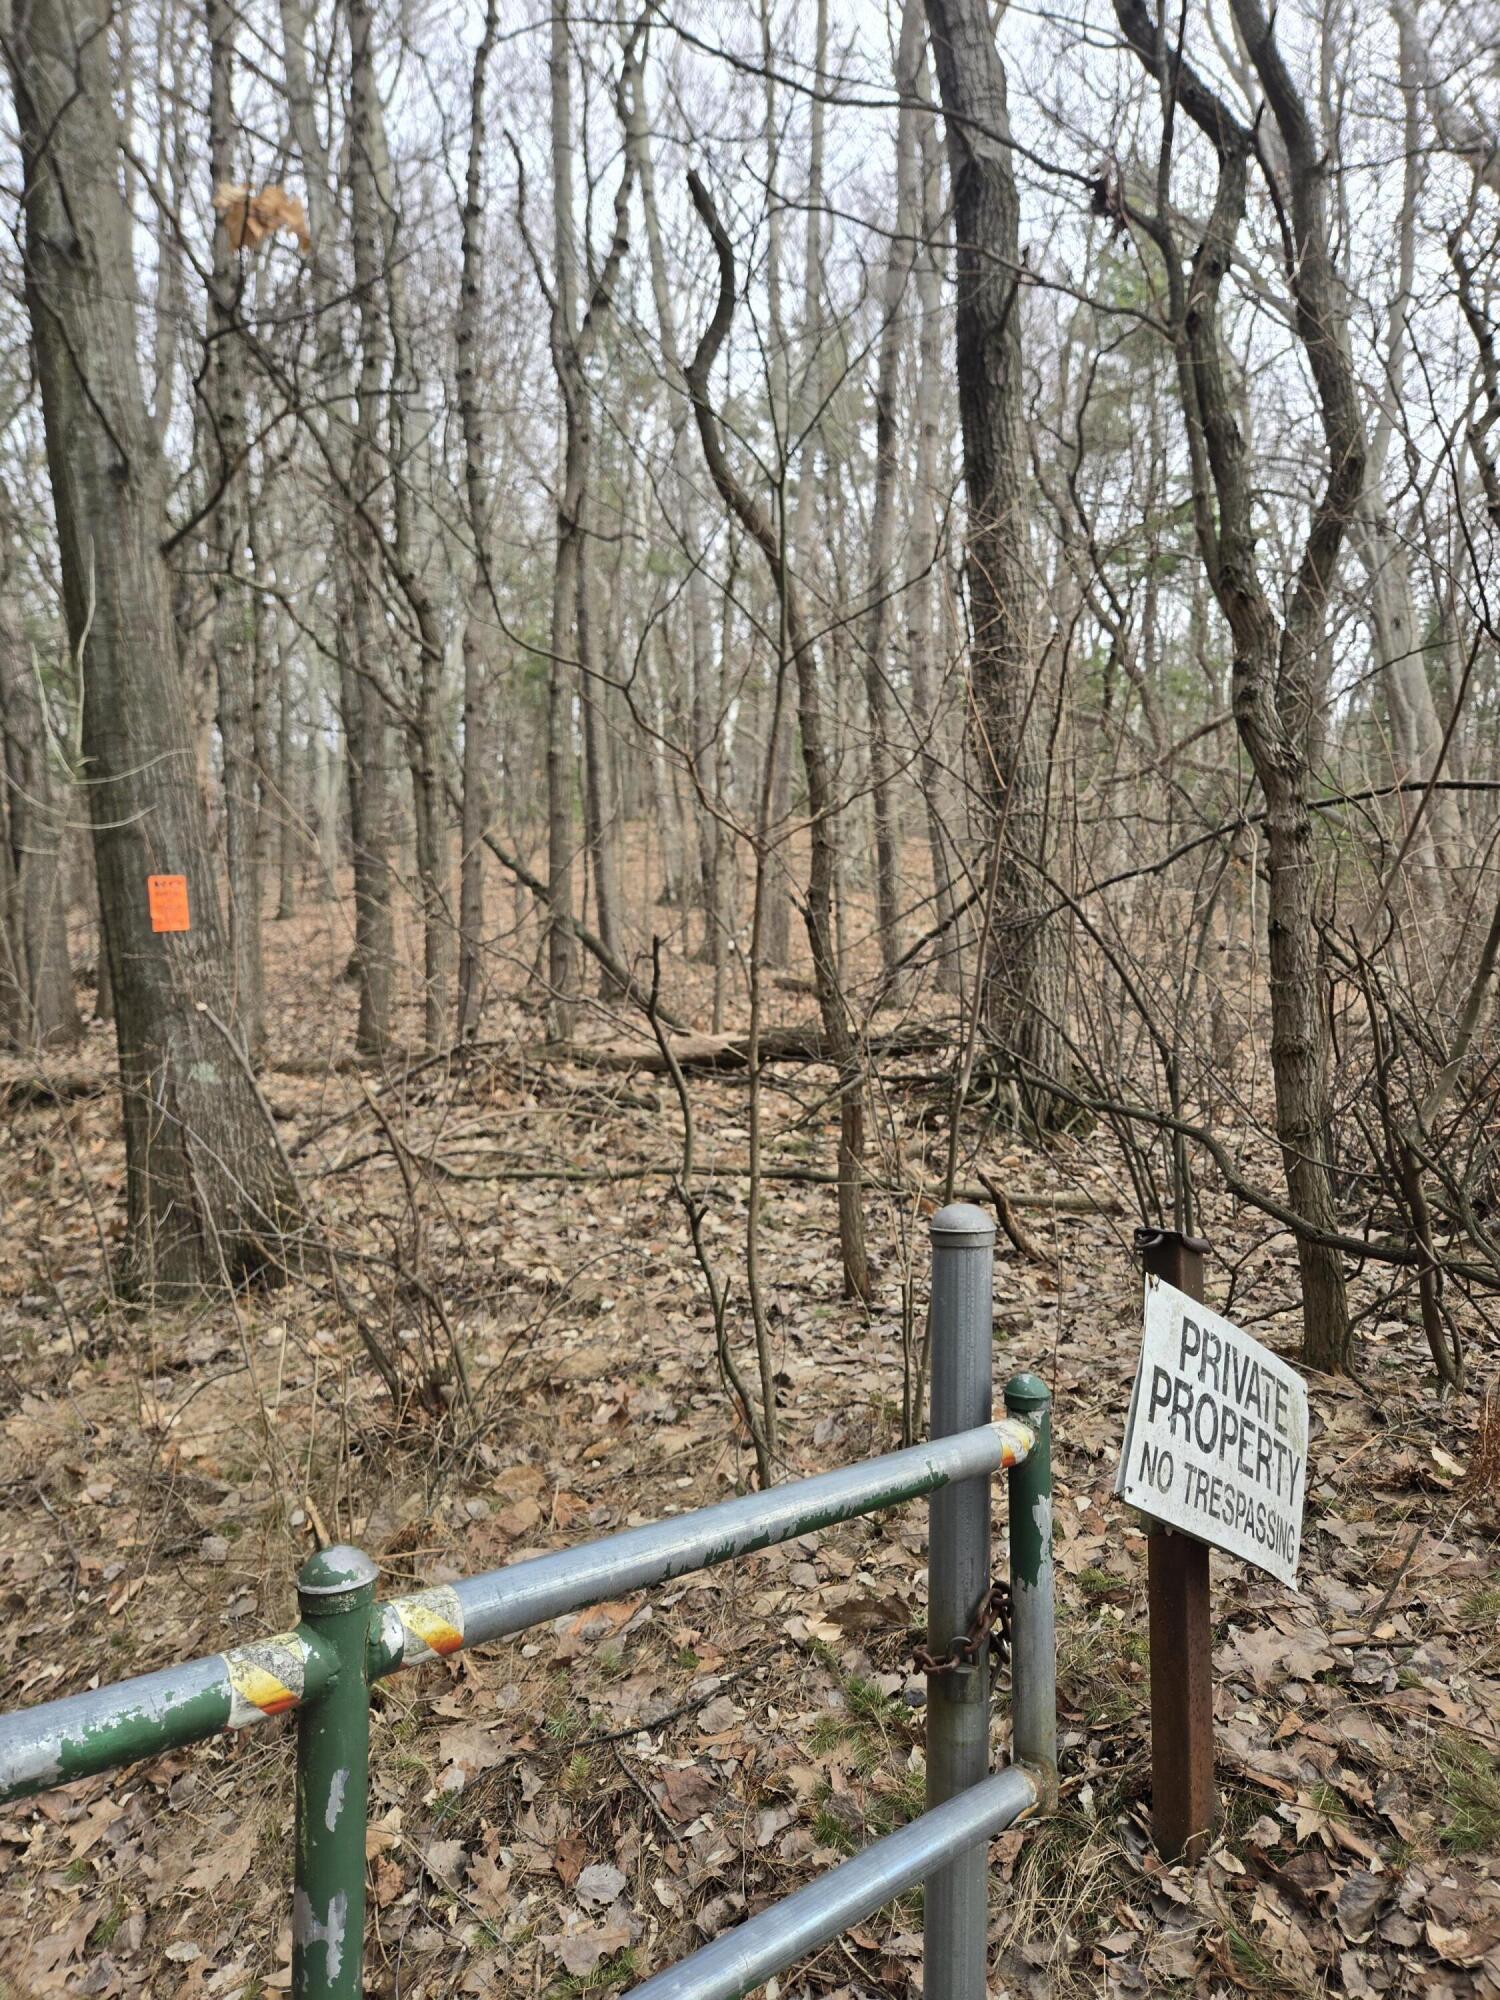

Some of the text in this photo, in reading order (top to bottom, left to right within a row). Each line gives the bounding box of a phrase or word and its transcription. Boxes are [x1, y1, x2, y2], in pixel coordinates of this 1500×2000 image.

[1148, 1365, 1300, 1506] PROPERTY
[1180, 1316, 1289, 1434] PRIVATE
[1138, 1441, 1295, 1565] NO TRESPASSING
